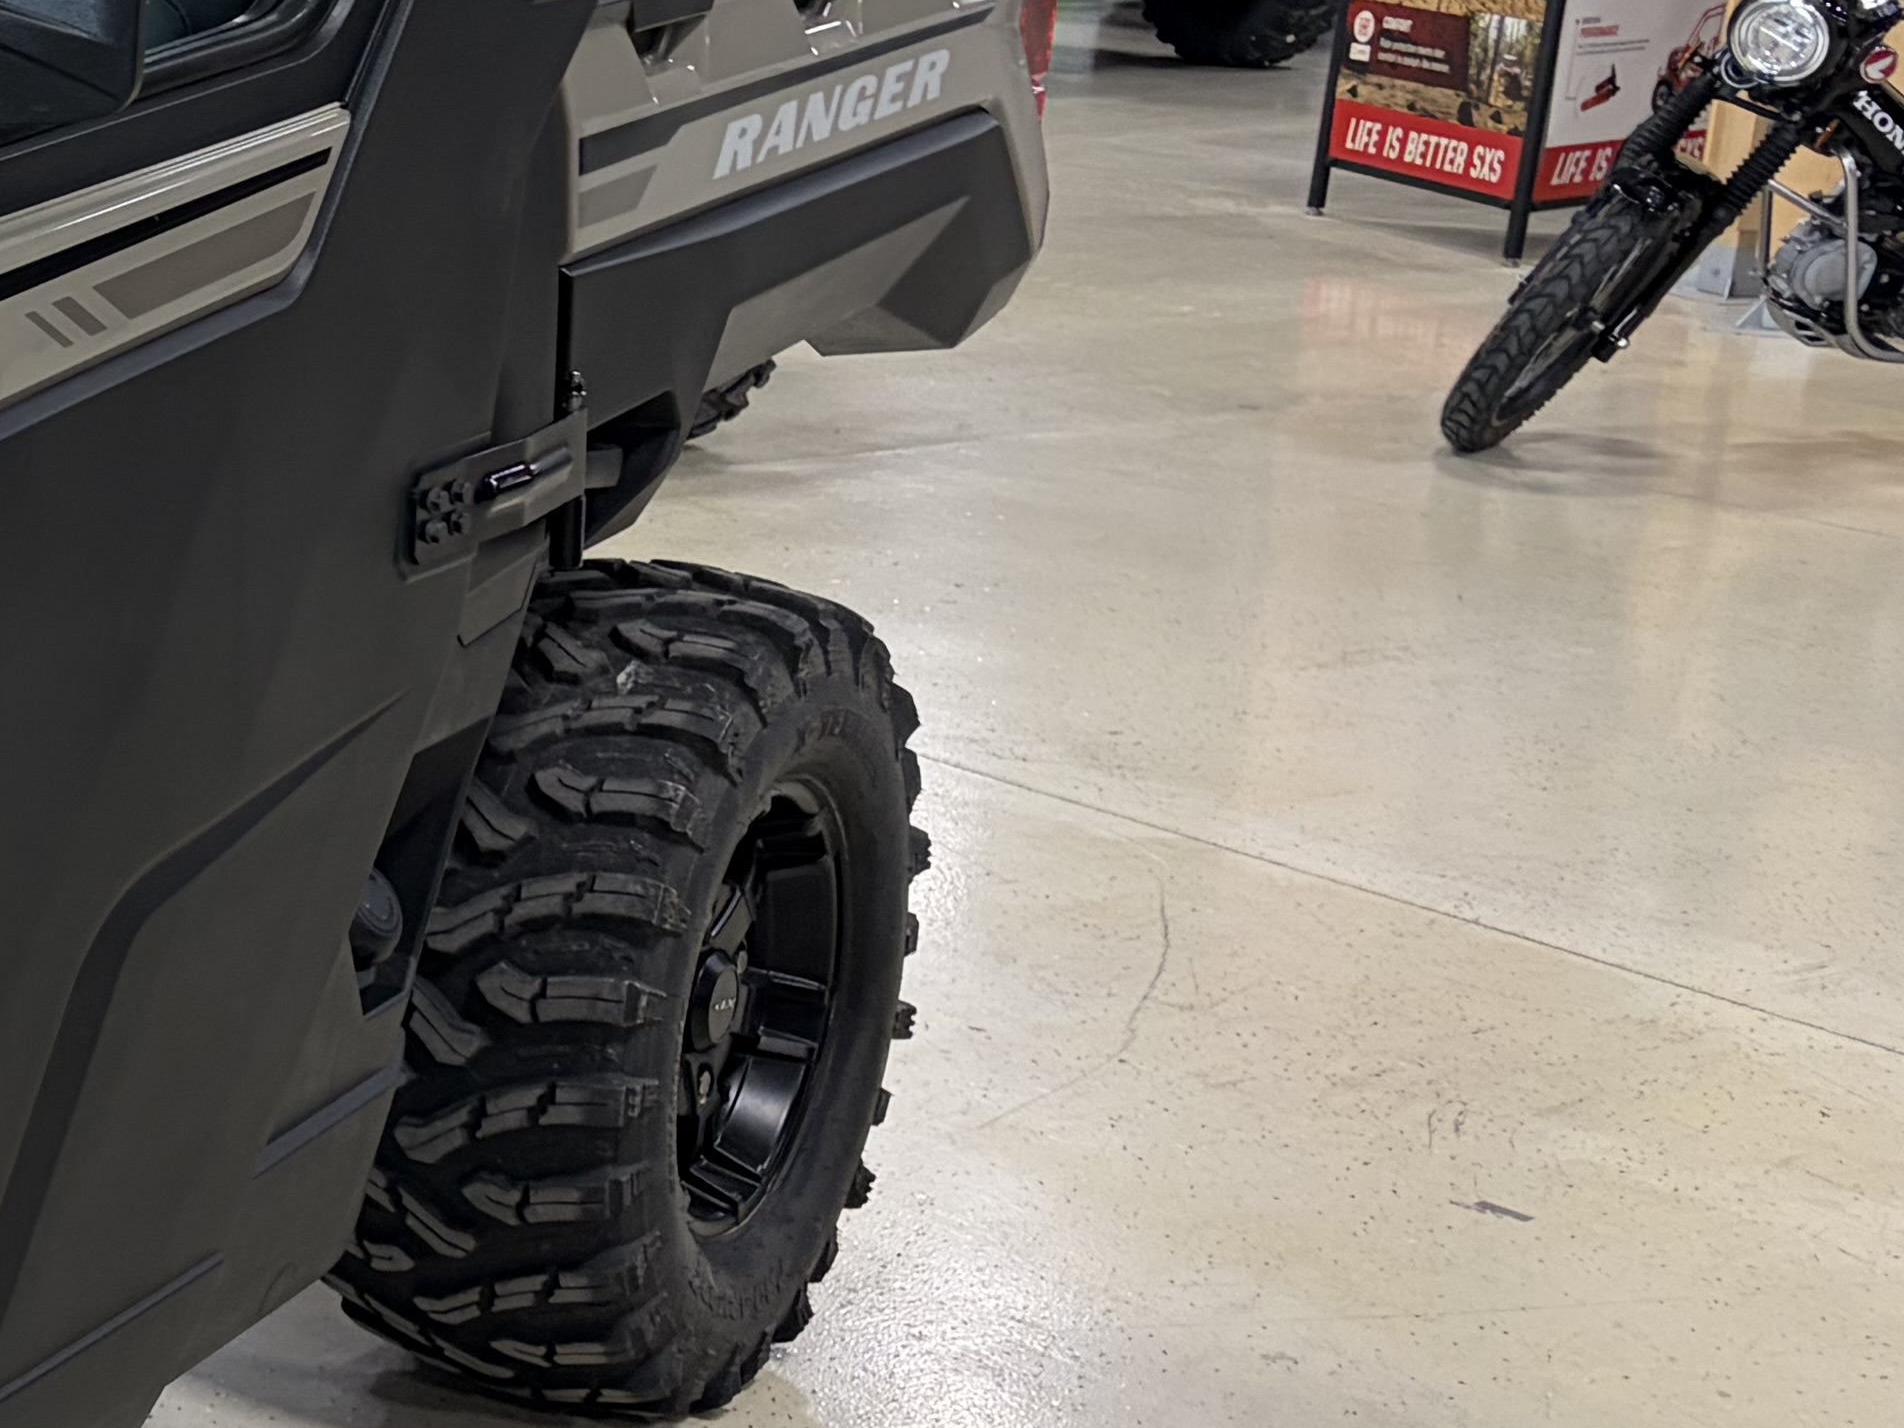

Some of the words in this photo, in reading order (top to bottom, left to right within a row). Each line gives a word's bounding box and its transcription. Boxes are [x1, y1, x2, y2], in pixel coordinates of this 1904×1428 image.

[713, 48, 949, 181] RANGER
[1853, 90, 1904, 155] HON
[1345, 117, 1382, 154] LIFE
[1383, 125, 1403, 158] IS
[1403, 130, 1468, 174] BETTER
[1469, 145, 1505, 183] SXS
[1550, 151, 1587, 186] LIFE
[1588, 147, 1613, 182] IS
